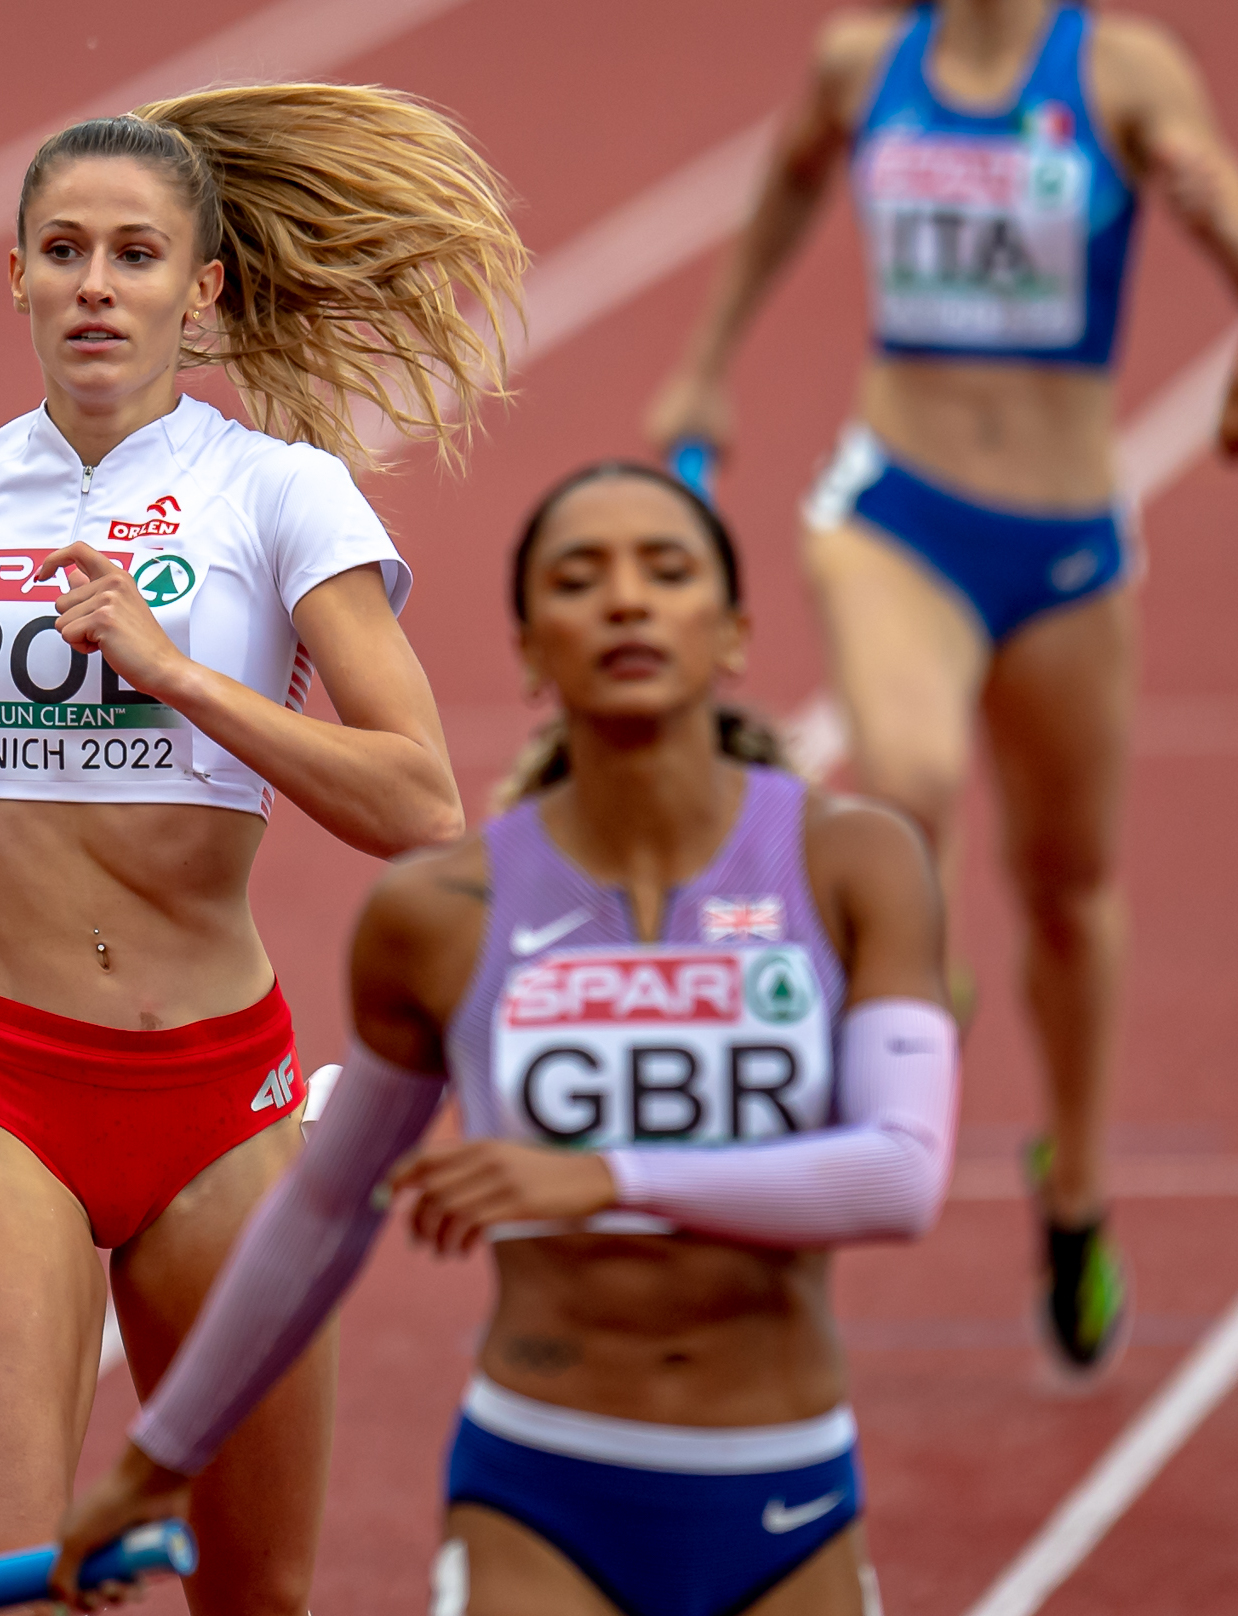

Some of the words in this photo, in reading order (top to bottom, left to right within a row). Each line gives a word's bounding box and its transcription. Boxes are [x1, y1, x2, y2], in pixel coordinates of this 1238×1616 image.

[894, 211, 1038, 284] ITA
[112, 521, 175, 539] ORLEN
[80, 737, 174, 770] 2022
[512, 963, 733, 1021] SPAR
[523, 1043, 798, 1143] GBR
